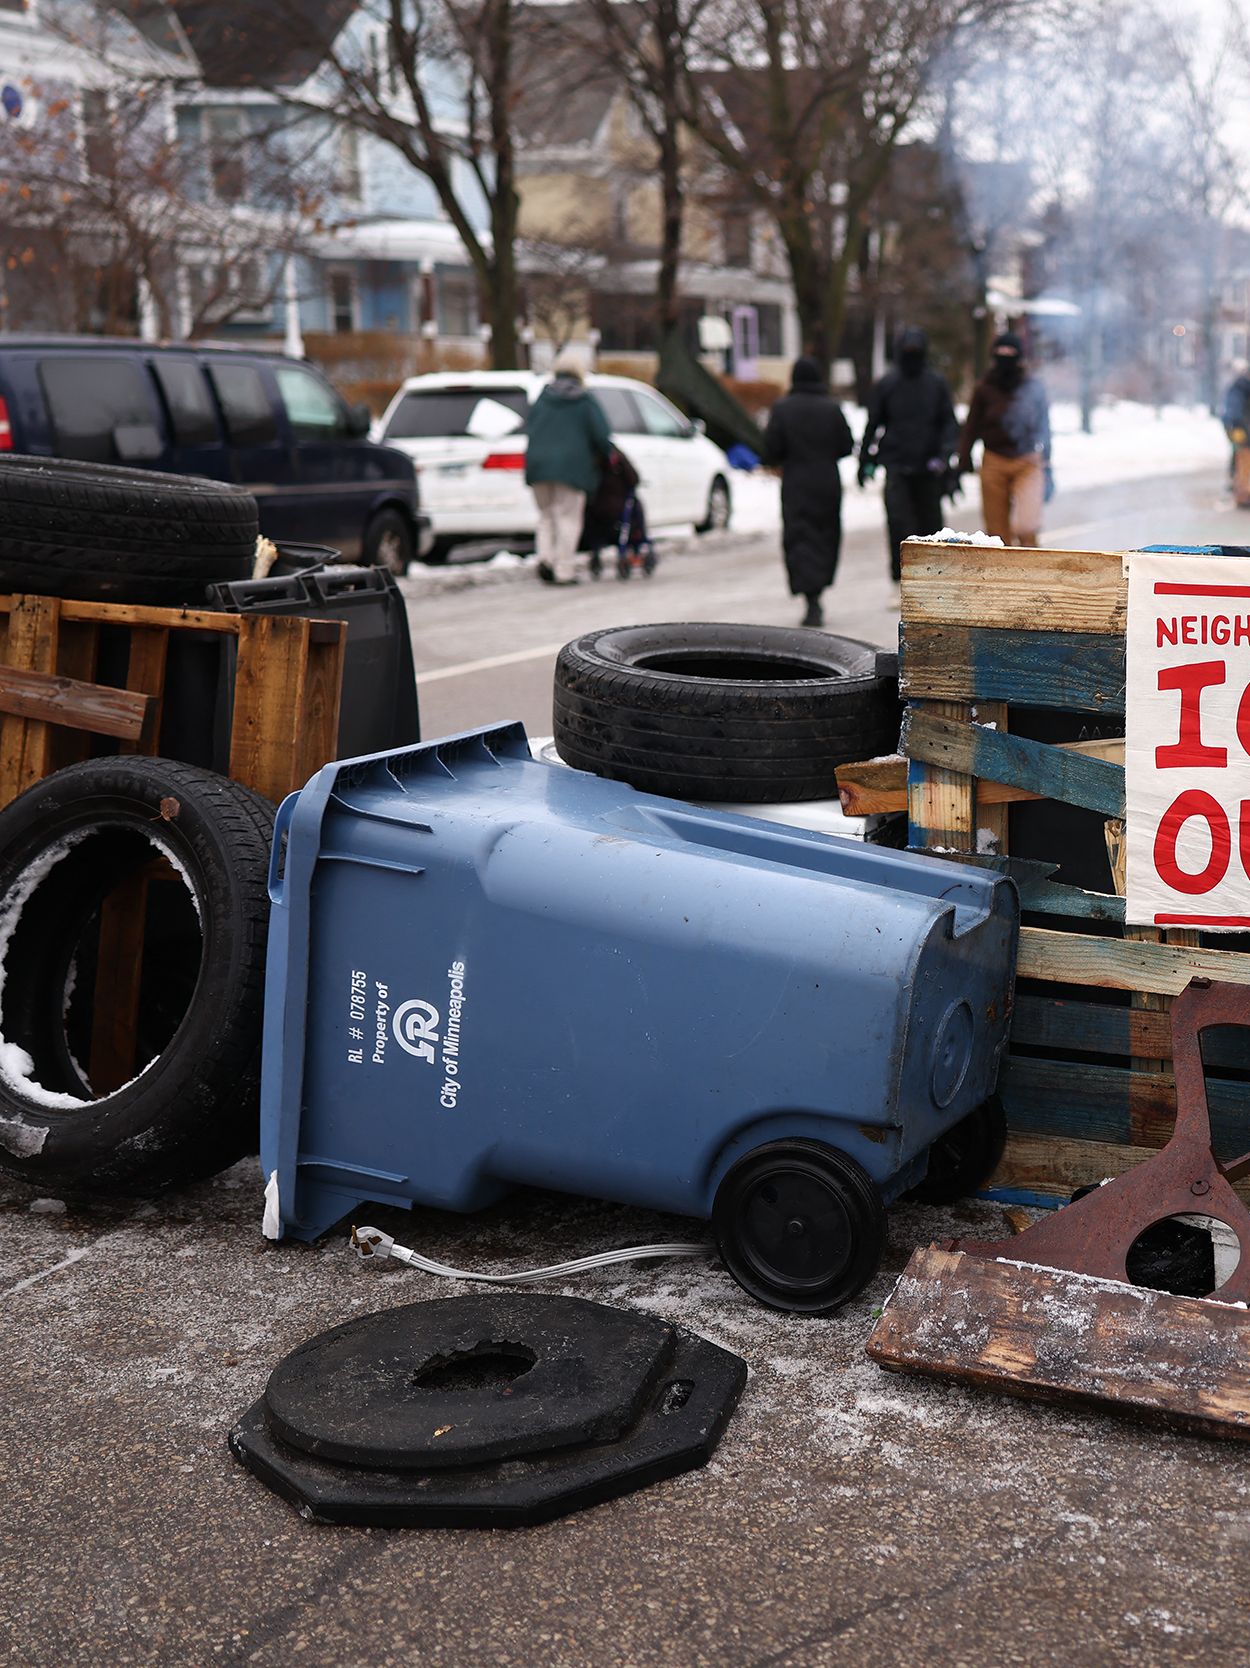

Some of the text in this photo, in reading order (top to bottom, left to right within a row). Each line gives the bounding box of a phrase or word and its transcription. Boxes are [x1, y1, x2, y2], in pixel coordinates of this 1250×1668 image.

[347, 970, 367, 1064] RL # 078755
[372, 981, 390, 1064] Property of
[439, 961, 467, 1109] City of Minneapolis
